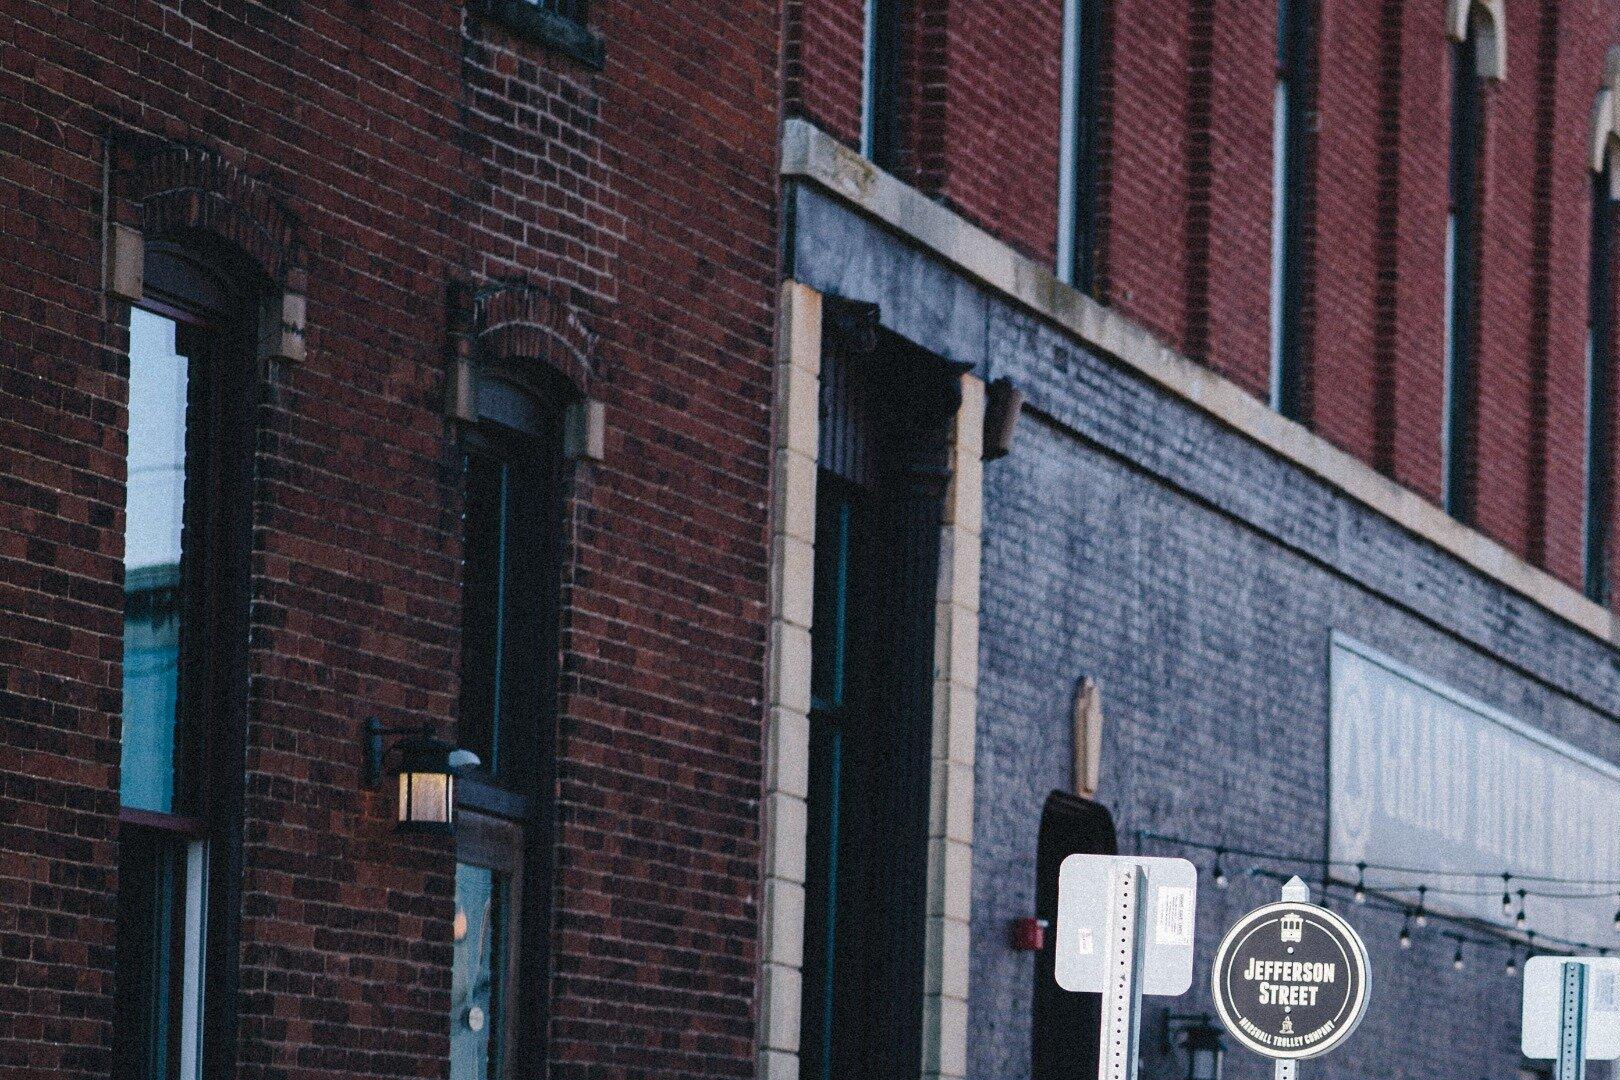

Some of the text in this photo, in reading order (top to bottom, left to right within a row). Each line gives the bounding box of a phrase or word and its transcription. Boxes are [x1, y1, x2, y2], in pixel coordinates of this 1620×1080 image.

[1244, 957, 1335, 983] JEFFERSON
[1259, 981, 1319, 1006] STREET
[1239, 1017, 1335, 1047] MARSHALL TROLLEY COMPANY
